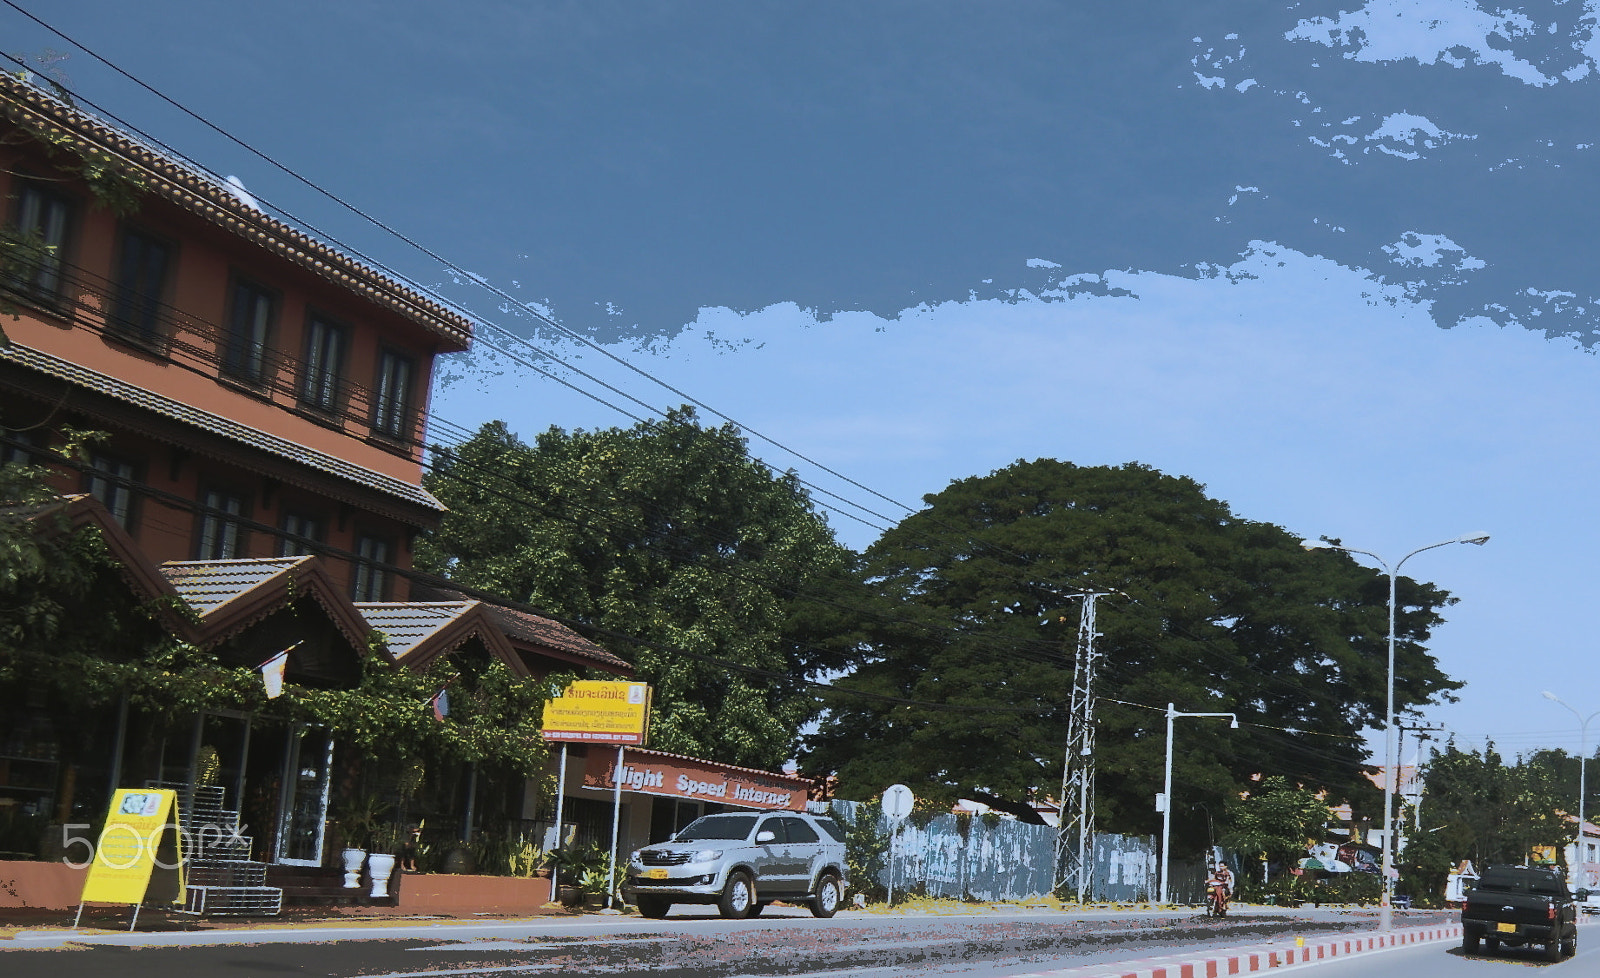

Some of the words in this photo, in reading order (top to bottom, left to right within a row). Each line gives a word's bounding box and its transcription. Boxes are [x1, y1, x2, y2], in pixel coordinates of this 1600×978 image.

[612, 764, 664, 790] Night
[676, 774, 728, 798] Speed
[733, 783, 791, 807] Internet
